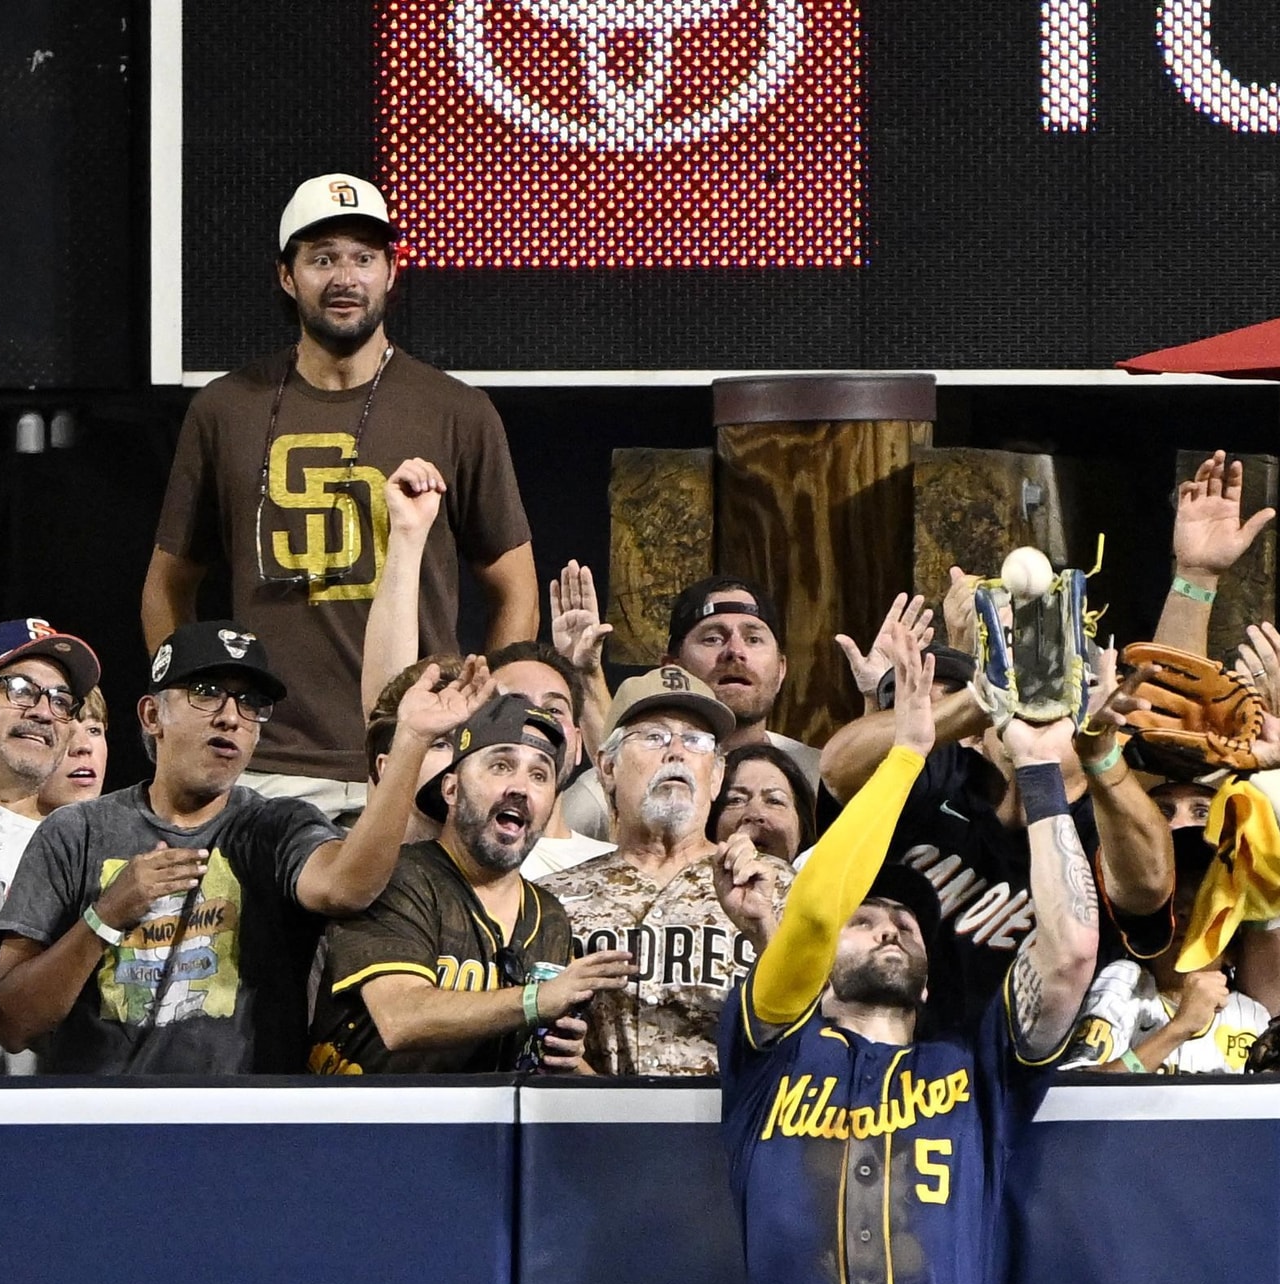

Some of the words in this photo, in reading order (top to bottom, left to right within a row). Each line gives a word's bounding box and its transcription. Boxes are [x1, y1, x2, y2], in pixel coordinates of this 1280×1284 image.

[328, 181, 359, 208] SD
[269, 432, 391, 605] SD
[761, 1068, 971, 1141] Milwaukee
[914, 1137, 953, 1205] 5
